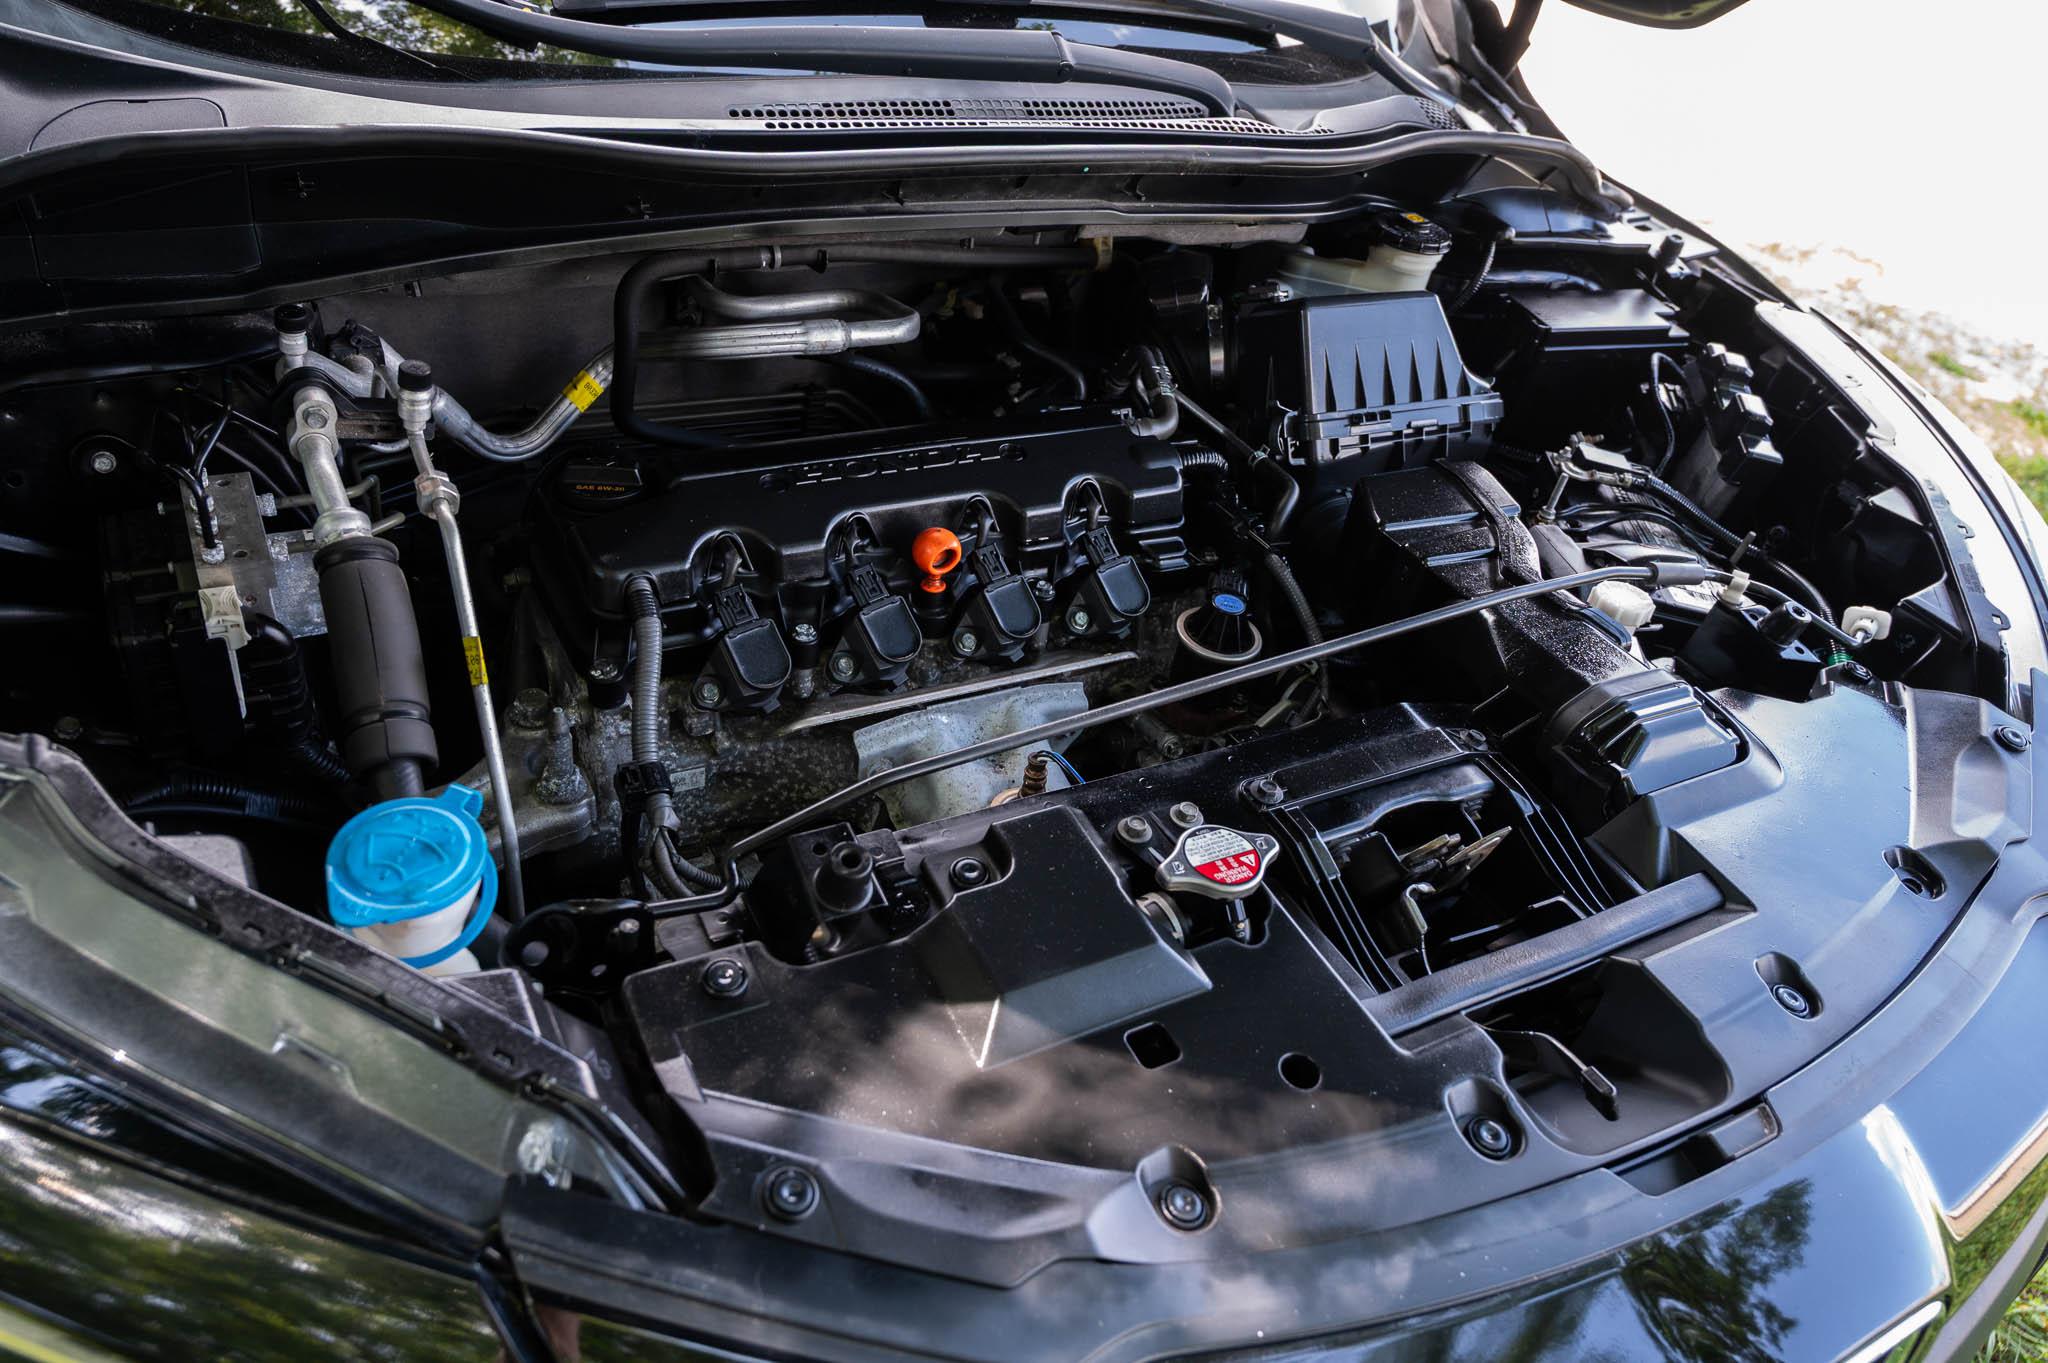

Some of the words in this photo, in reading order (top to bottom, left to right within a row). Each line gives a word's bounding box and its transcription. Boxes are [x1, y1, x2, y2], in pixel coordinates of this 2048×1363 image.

[789, 449, 1001, 486] HONDA
[1213, 865, 1248, 881] WARNING
[1224, 870, 1254, 884] DANGER
